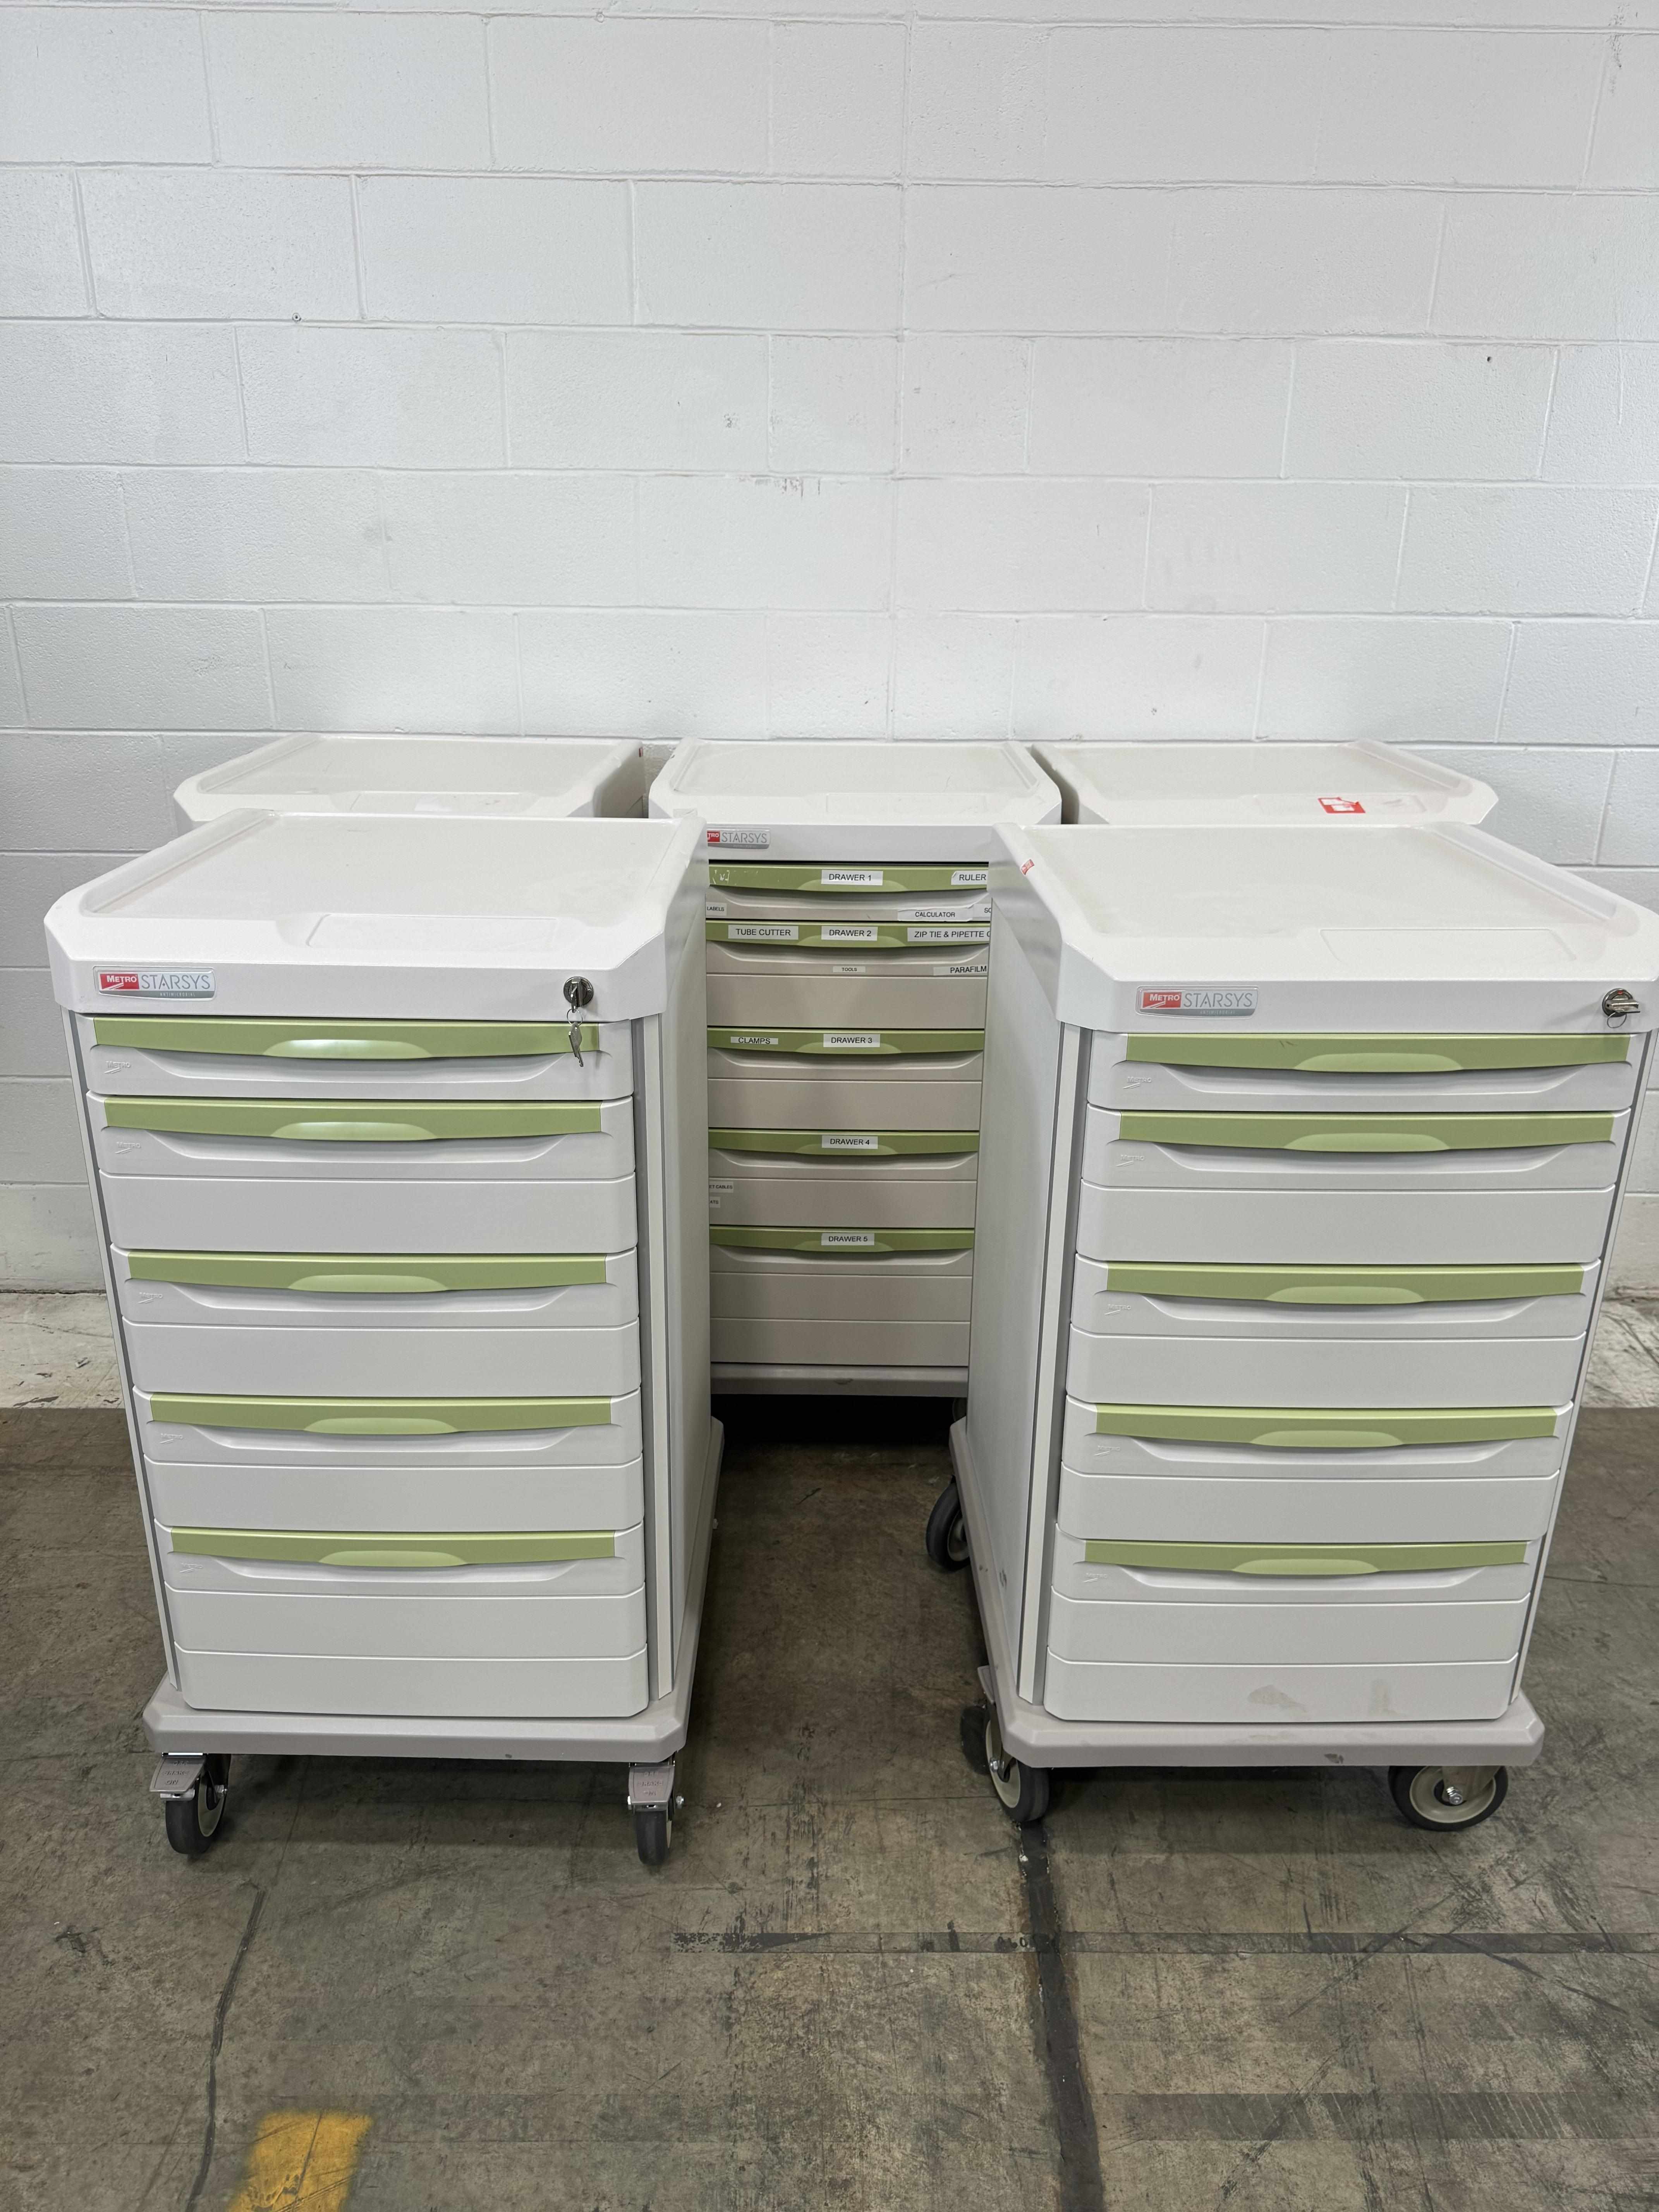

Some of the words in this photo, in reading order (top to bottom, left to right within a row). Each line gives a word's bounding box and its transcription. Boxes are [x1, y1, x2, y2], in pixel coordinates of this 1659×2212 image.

[722, 832, 767, 843] STARSYS
[141, 974, 210, 989] STARSYS
[1183, 993, 1252, 1007] STARSYS
